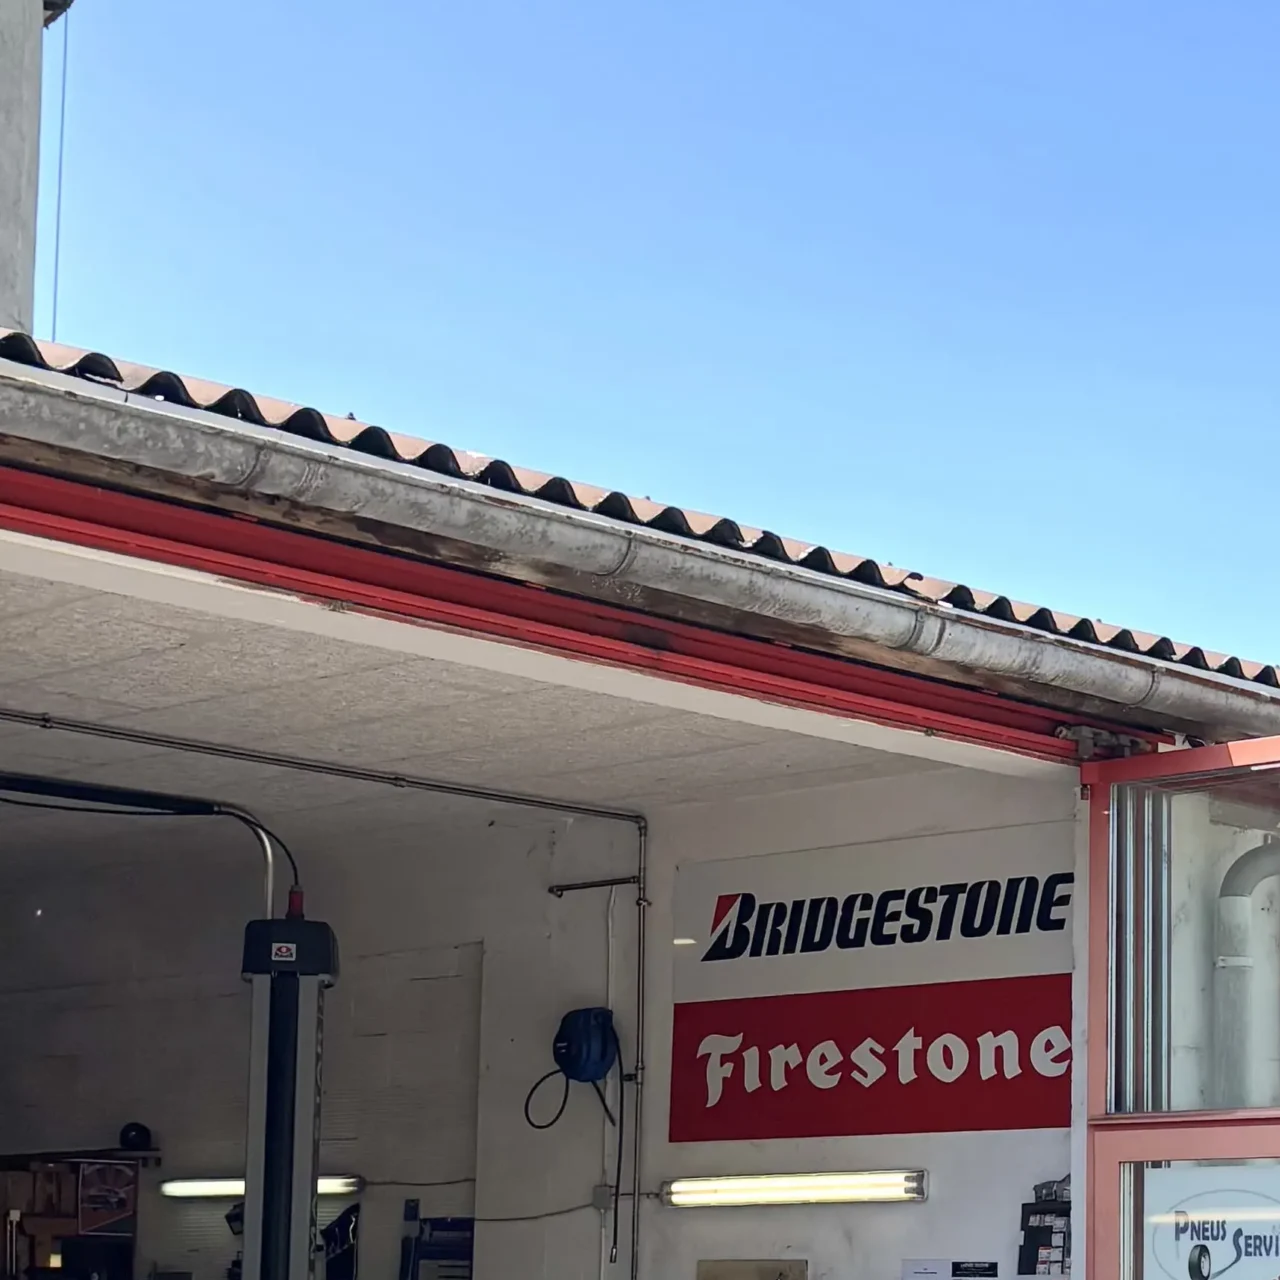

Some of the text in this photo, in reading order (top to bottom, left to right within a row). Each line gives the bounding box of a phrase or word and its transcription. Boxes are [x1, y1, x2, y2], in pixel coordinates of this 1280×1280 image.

[700, 872, 1074, 961] BRIDGESTONE
[696, 1025, 1072, 1107] Firestone
[1174, 1211, 1227, 1242] PNEUS
